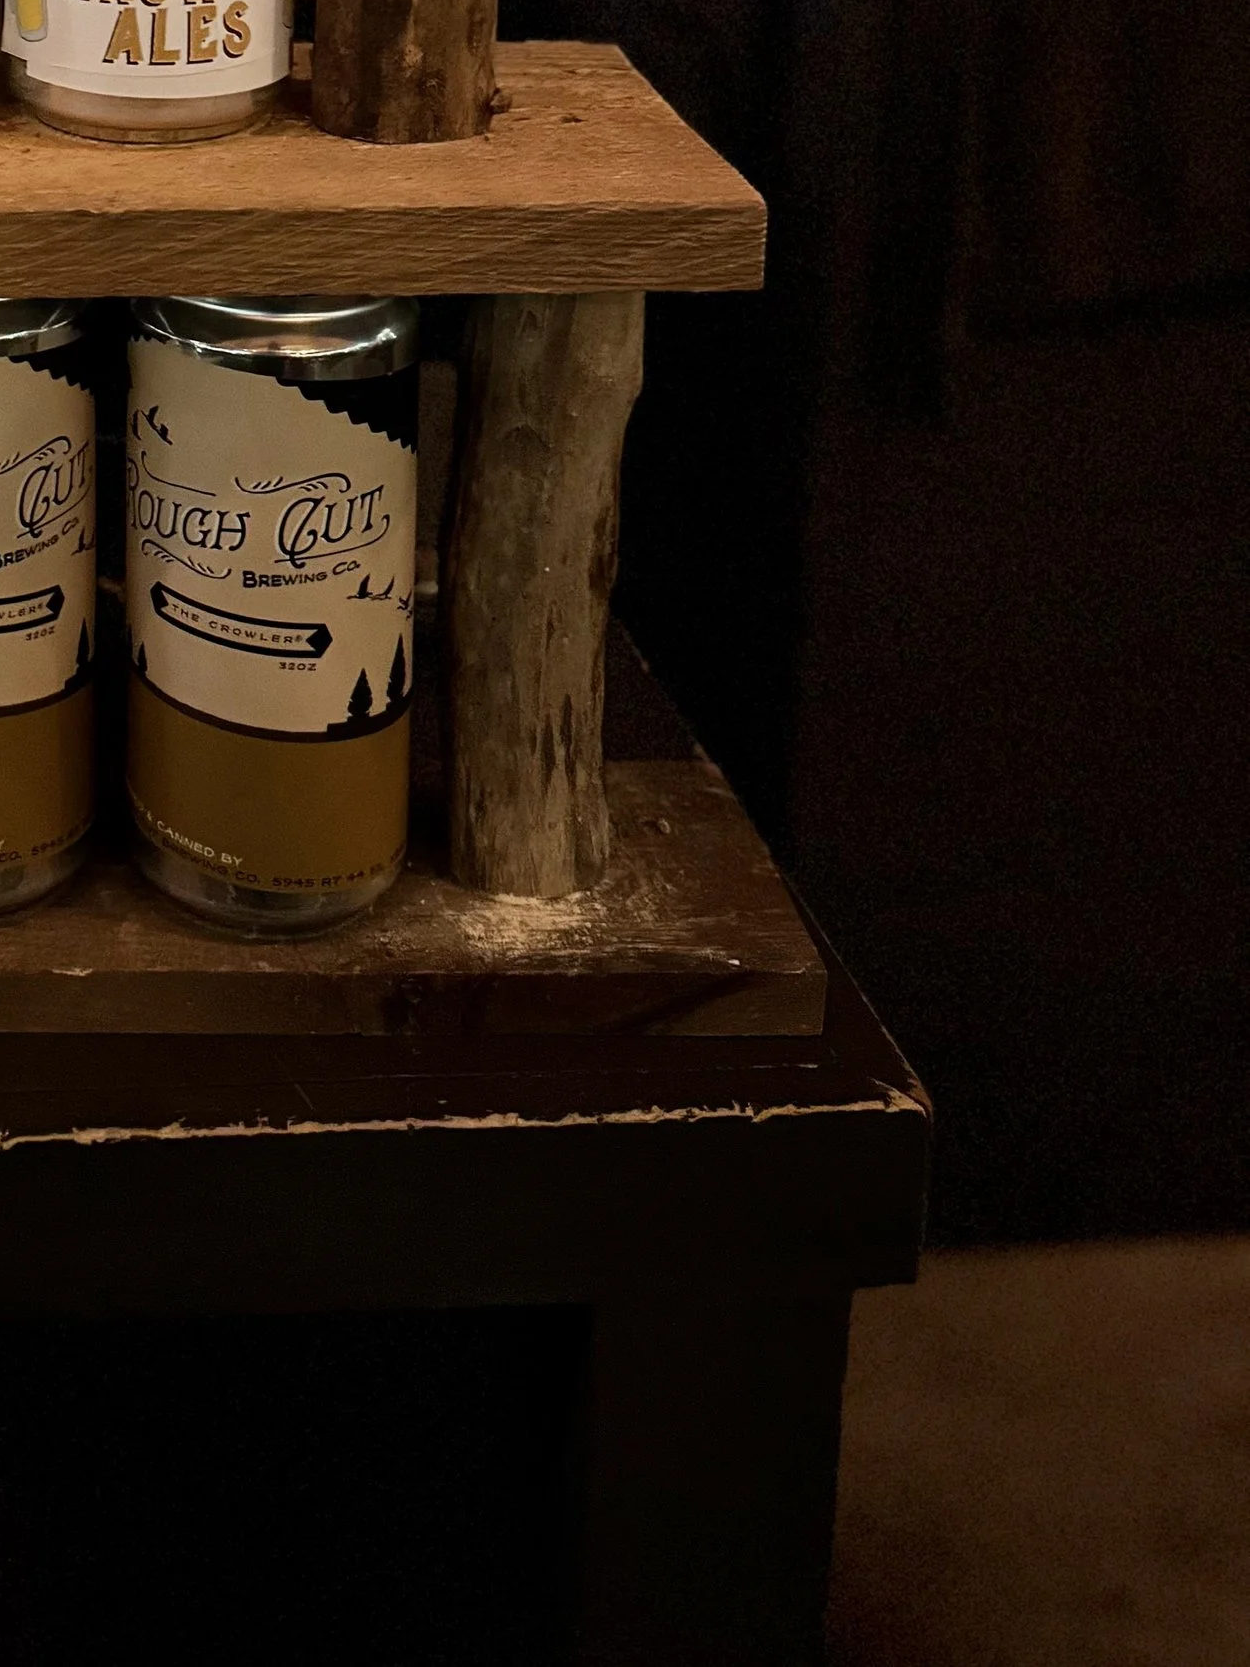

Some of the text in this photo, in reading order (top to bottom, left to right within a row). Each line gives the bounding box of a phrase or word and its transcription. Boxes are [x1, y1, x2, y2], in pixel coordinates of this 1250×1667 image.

[102, 0, 252, 66] ALES
[242, 570, 328, 589] BREWING
[171, 603, 200, 623] THE
[157, 820, 215, 858] CANNED
[221, 852, 243, 868] BY
